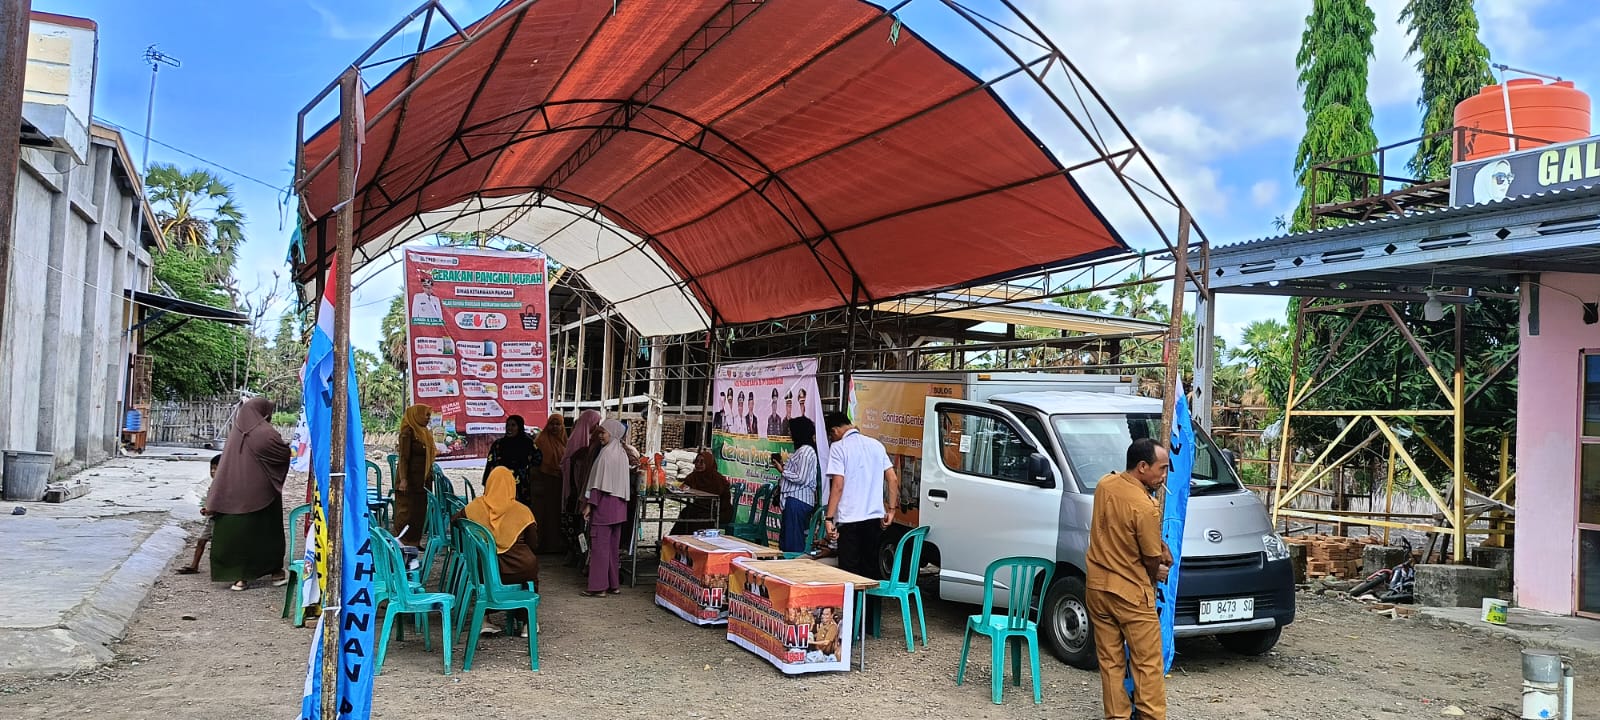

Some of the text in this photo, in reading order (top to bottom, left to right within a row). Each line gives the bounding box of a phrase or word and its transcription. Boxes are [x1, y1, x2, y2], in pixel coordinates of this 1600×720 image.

[432, 269, 543, 285] GERAKAN PANGAN MURAH
[933, 386, 953, 395] BULOG
[881, 410, 905, 425] Contact
[905, 413, 924, 428] Cente
[1201, 602, 1212, 615] DD
[1217, 600, 1237, 613] 8473
